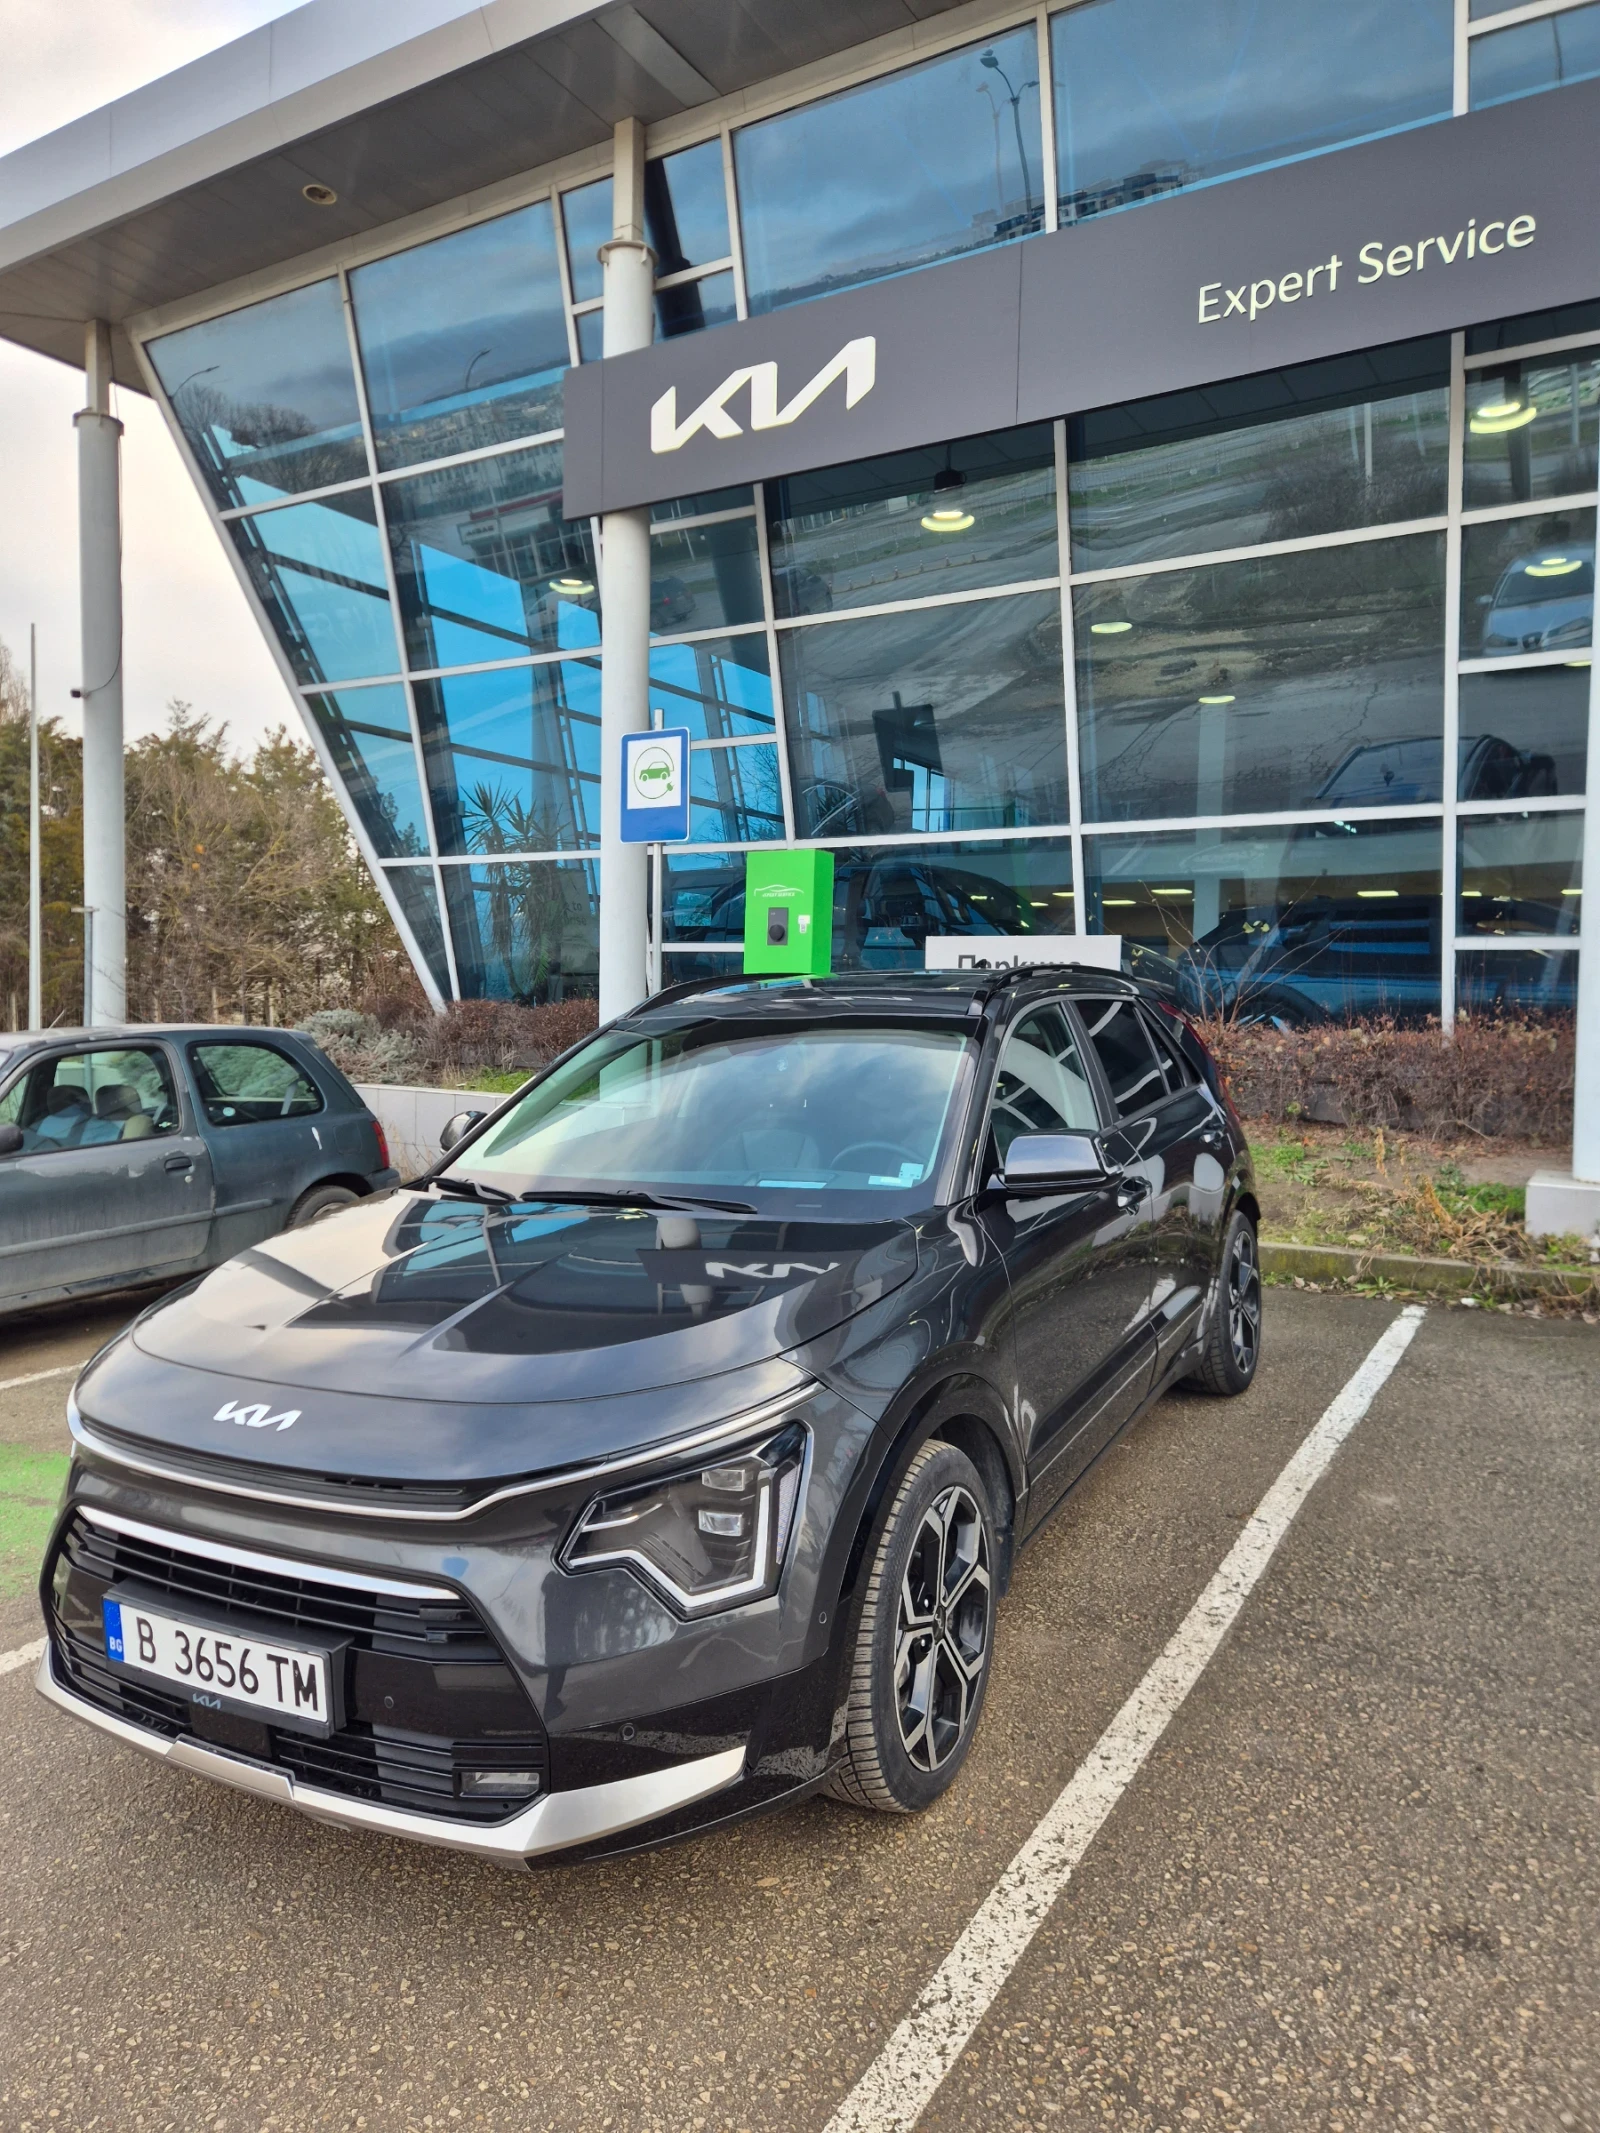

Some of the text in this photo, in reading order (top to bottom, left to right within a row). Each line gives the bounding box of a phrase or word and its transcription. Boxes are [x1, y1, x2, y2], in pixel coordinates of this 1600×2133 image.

[1198, 214, 1537, 323] Expert Service
[651, 335, 876, 454] KIA
[213, 1400, 303, 1432] KIA
[109, 1637, 123, 1653] BG
[136, 1616, 319, 1712] B 3656 TM
[192, 1693, 221, 1710] KIA
